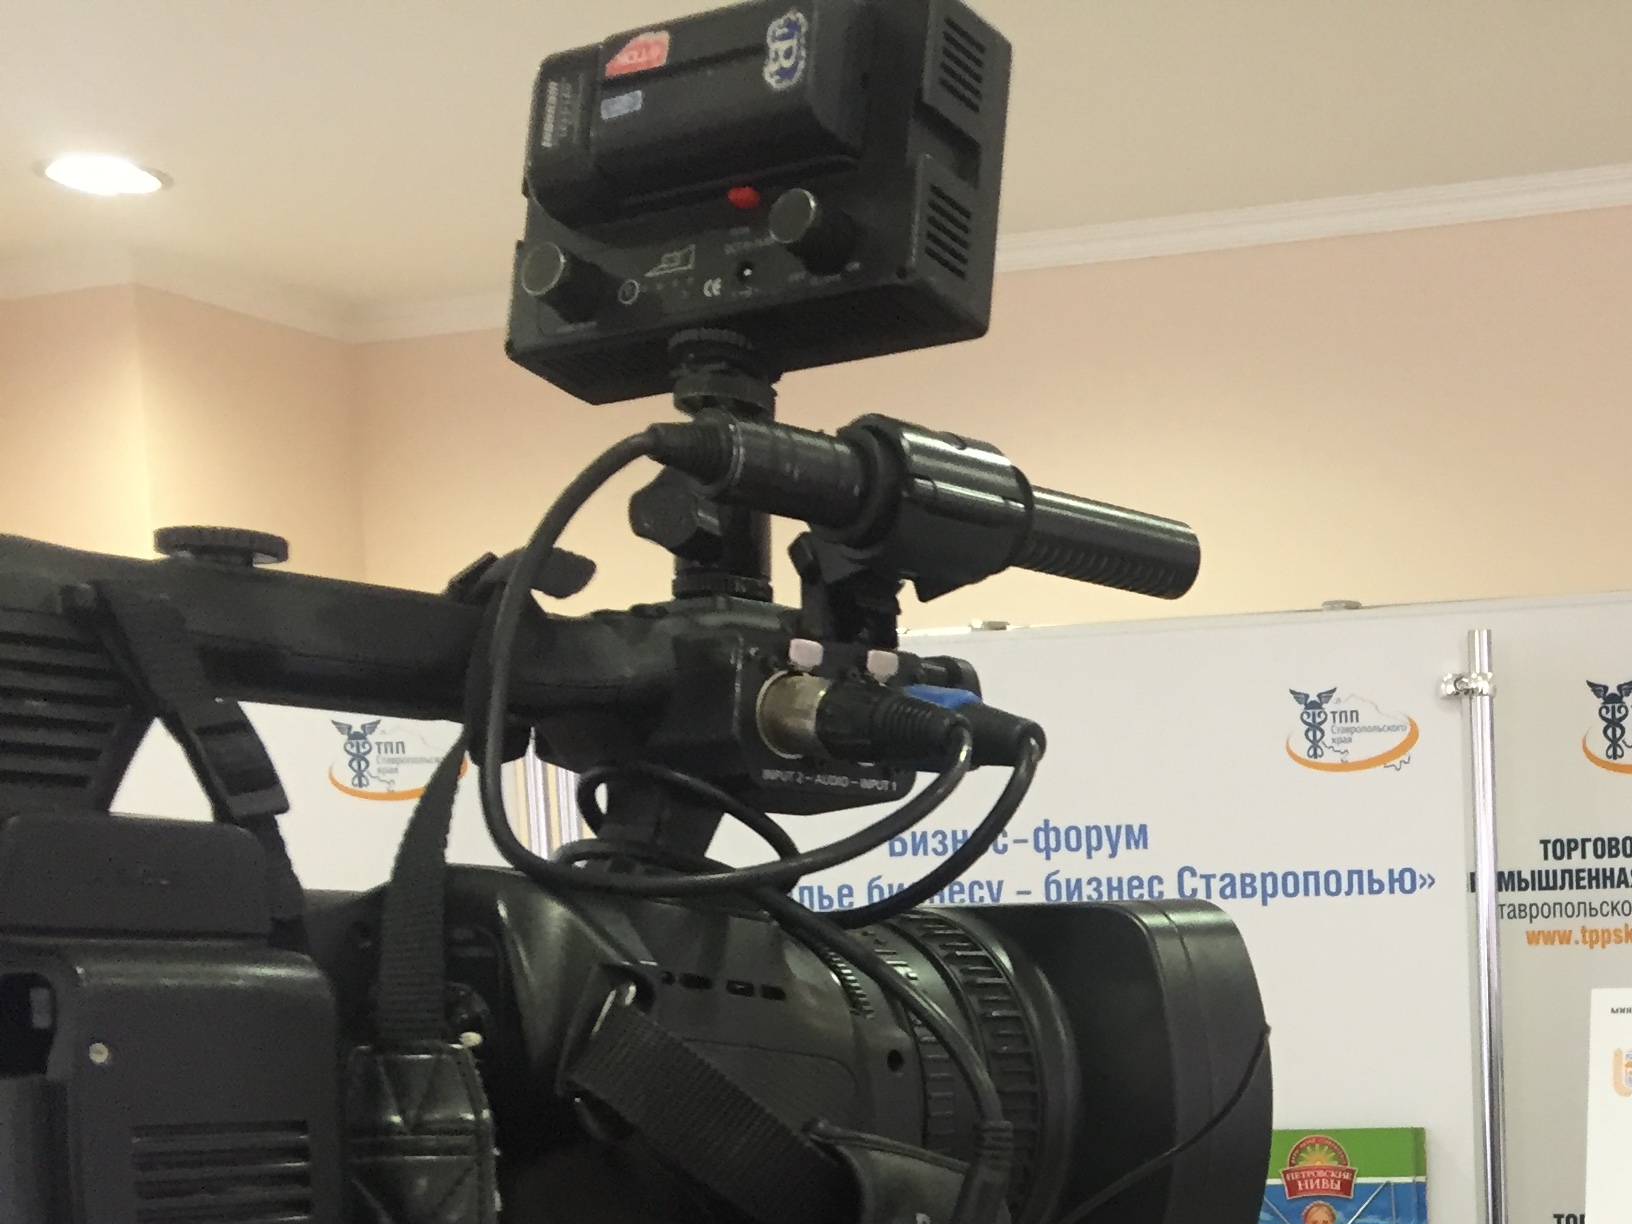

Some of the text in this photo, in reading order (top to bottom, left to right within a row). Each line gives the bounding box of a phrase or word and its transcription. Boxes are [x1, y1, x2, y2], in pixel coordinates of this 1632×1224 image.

[1330, 709, 1360, 724] ТПП
[376, 741, 405, 756] ТПП
[888, 819, 1148, 860] Бизнс-форум
[1044, 867, 1436, 906] бизнес Ставрополью»
[1298, 1179, 1340, 1190] НИВЫ
